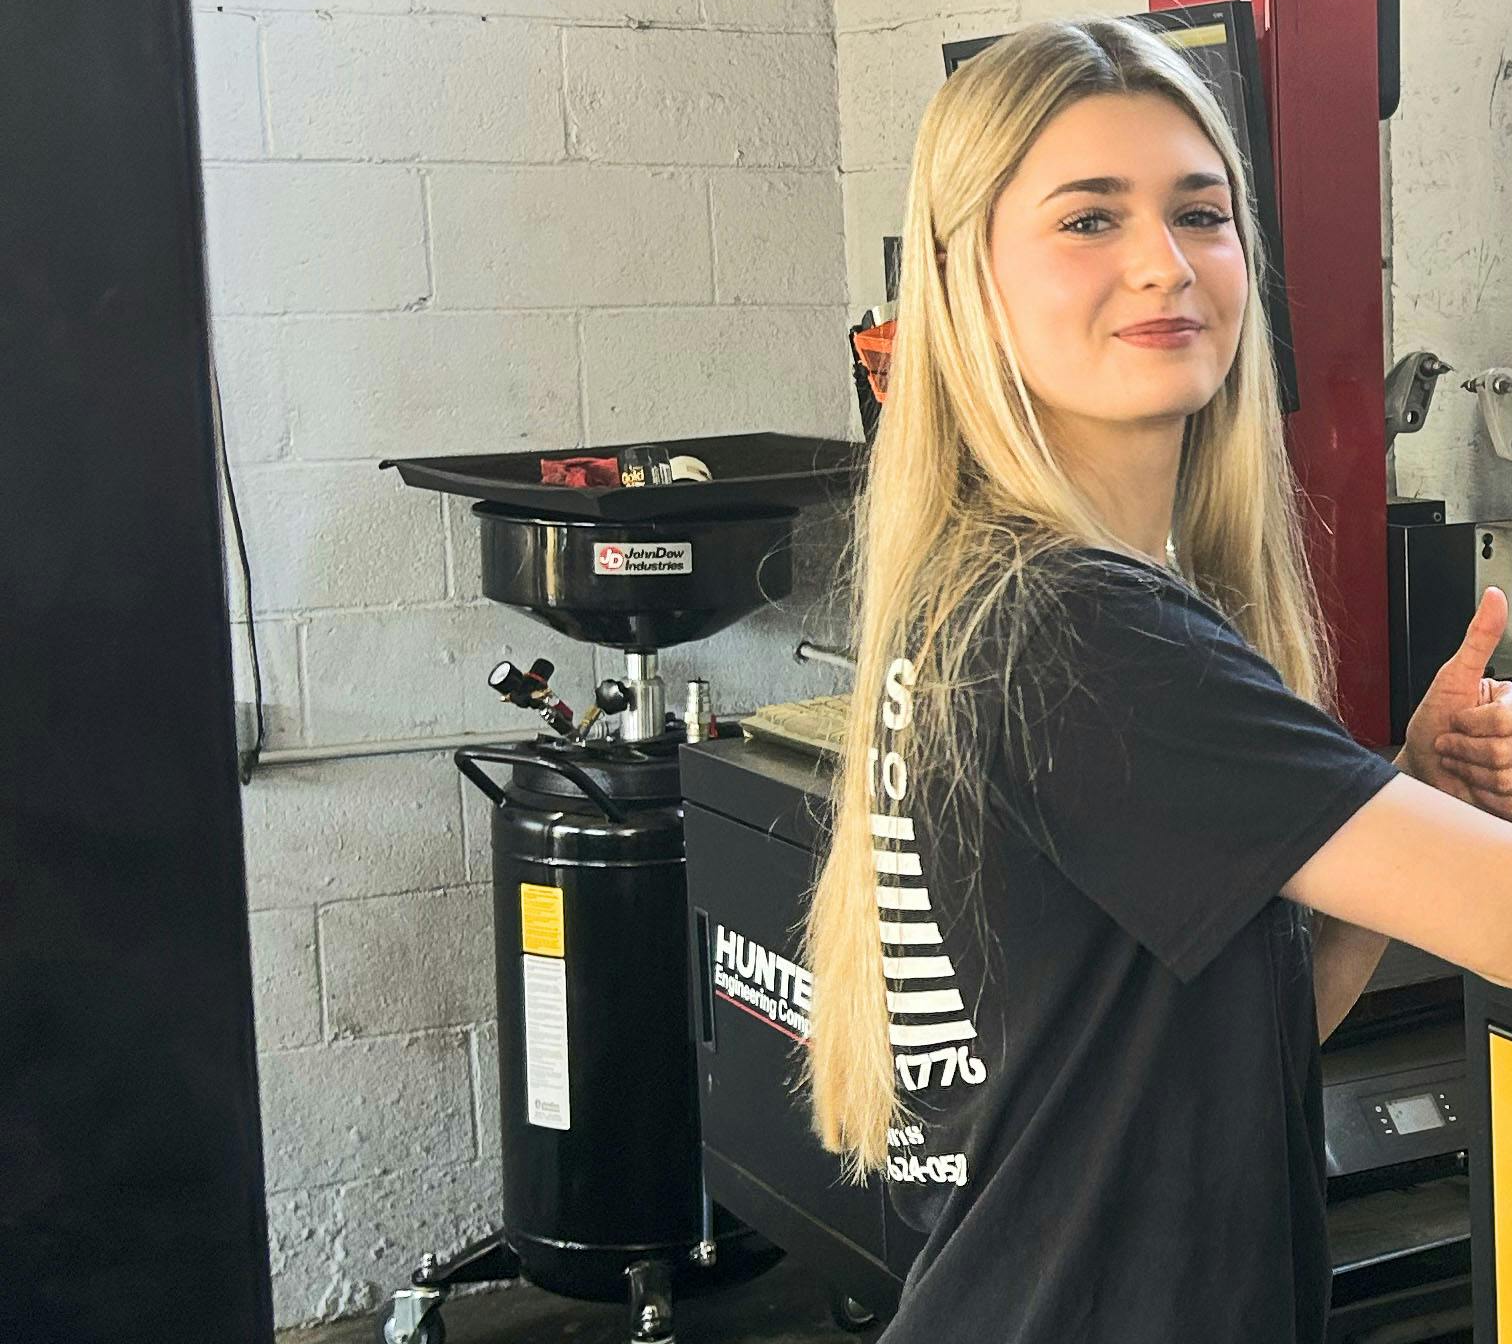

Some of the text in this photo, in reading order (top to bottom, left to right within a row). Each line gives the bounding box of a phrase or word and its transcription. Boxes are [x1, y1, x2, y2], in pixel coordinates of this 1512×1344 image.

[625, 547, 685, 559] JohnDow
[625, 561, 684, 571] Industries
[714, 962, 777, 1021] Engineering
